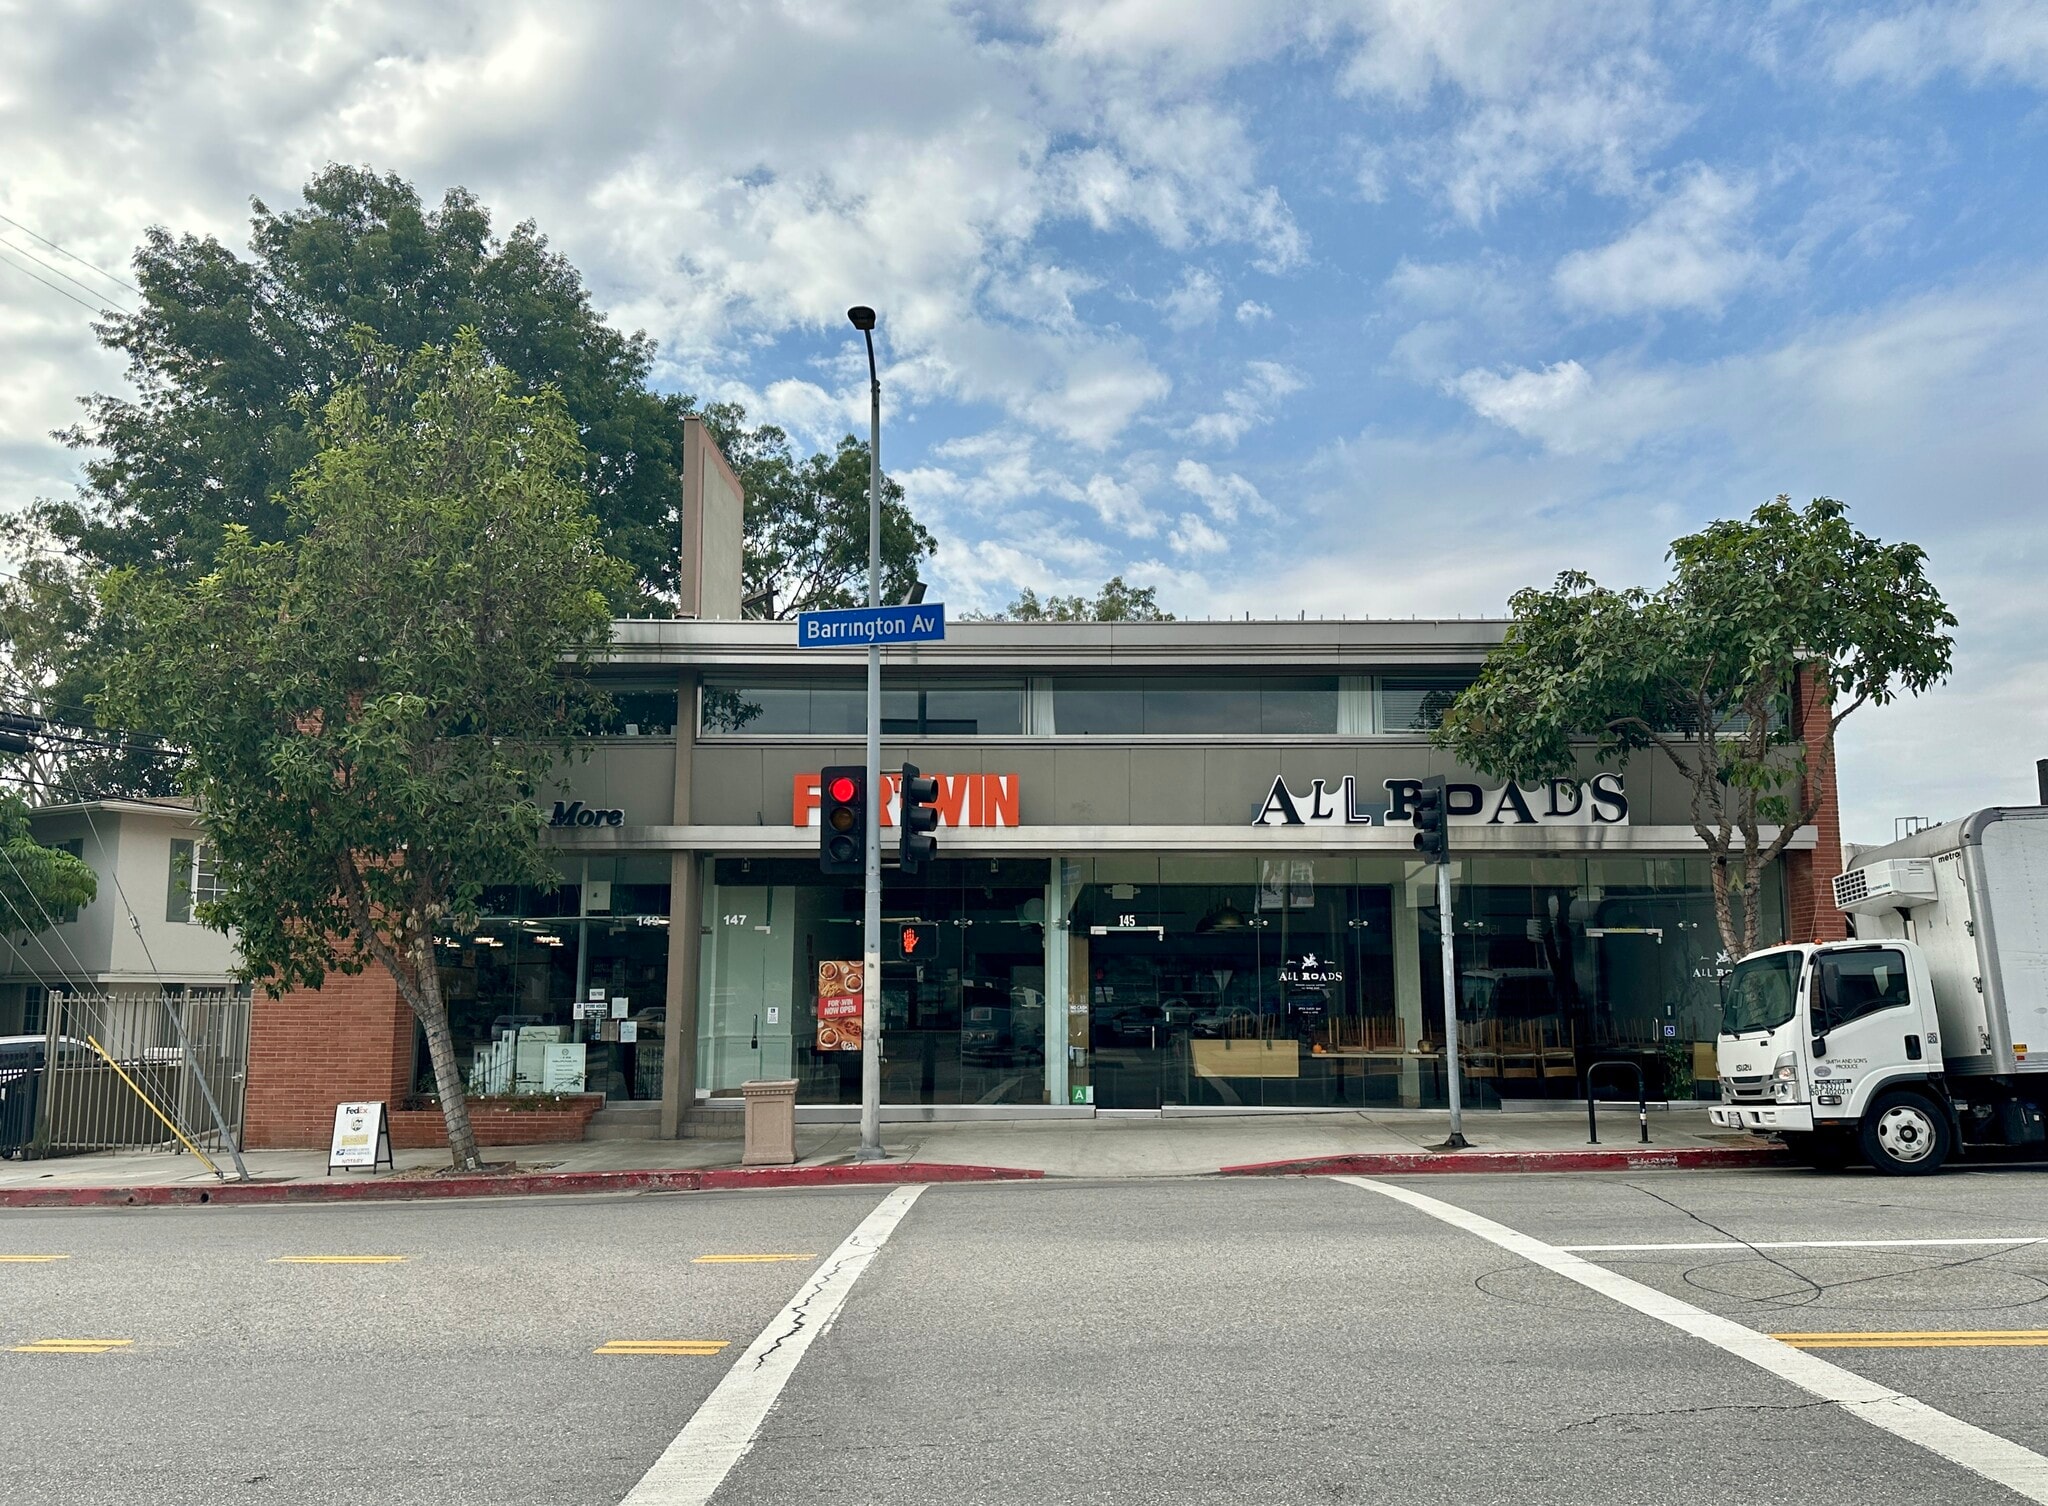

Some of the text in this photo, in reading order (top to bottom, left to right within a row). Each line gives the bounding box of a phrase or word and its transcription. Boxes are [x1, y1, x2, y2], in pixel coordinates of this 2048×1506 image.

[807, 614, 935, 641] Barrington Av
[1254, 772, 1629, 826] ALL ROADS
[548, 801, 625, 826] More
[636, 916, 660, 927] 149
[723, 914, 747, 926] 147
[1119, 915, 1135, 927] 145
[1279, 971, 1343, 981] ALL ROADS
[1692, 968, 1712, 977] ALL
[824, 1005, 856, 1015] NOW OPEN
[1735, 1064, 1753, 1072] ISUZU
[1075, 1089, 1084, 1099] A
[345, 1106, 368, 1114] FedEx
